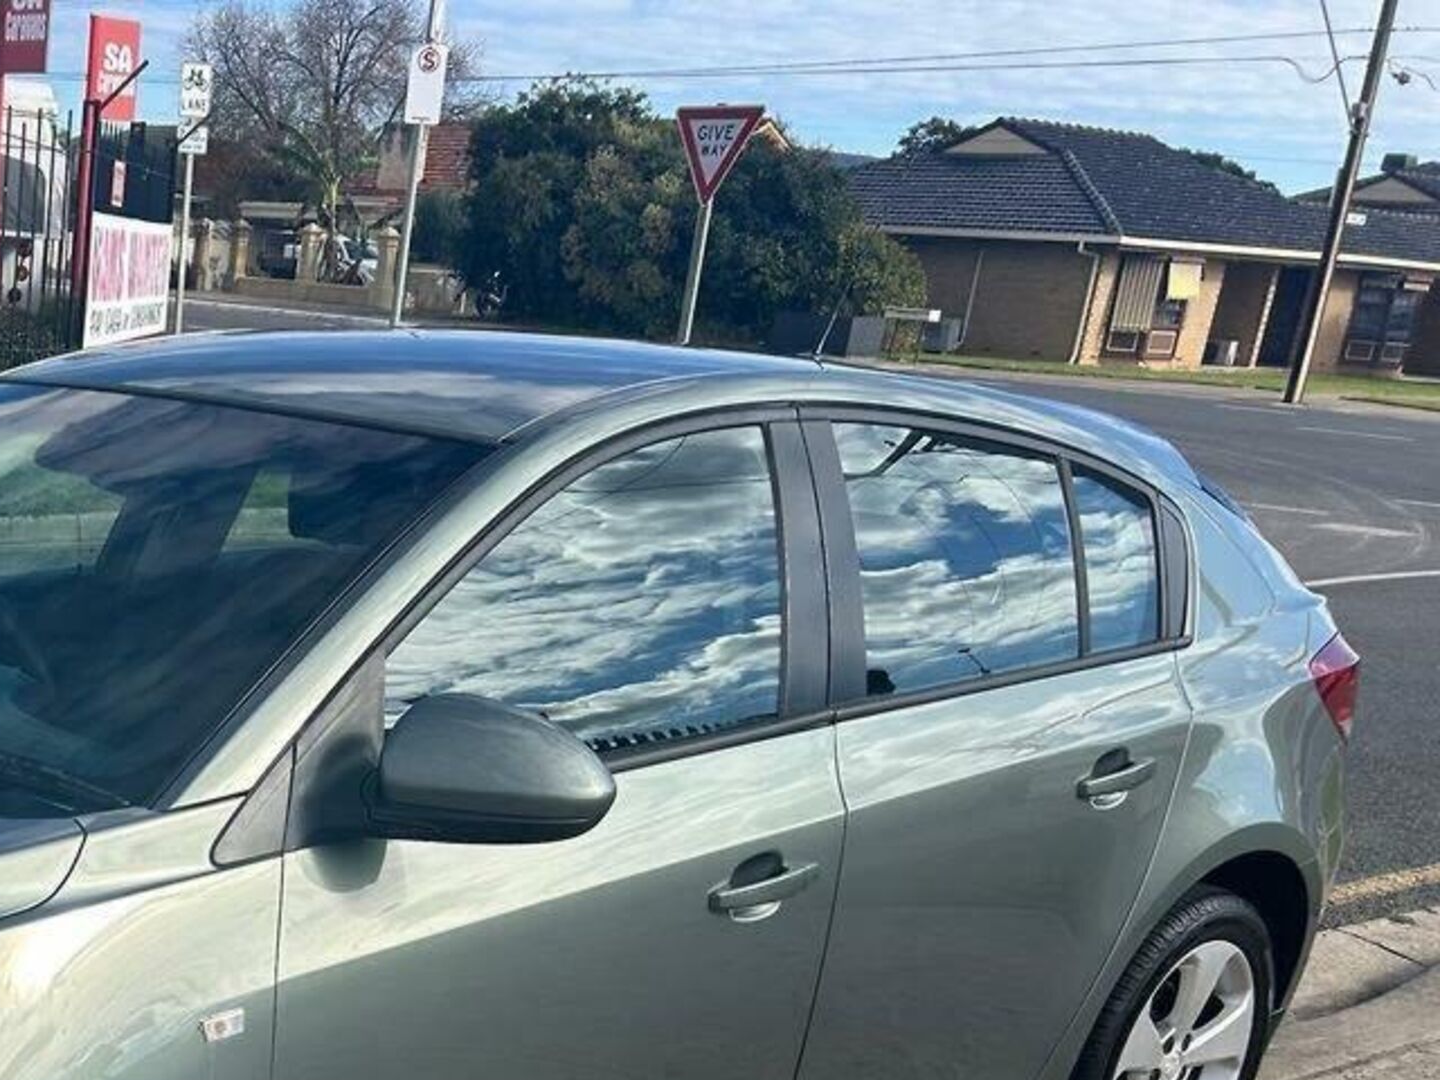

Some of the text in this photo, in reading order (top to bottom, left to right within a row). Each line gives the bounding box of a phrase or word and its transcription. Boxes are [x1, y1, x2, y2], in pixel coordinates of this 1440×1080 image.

[103, 42, 134, 72] SA
[423, 51, 435, 70] S
[697, 125, 736, 141] GIVE
[701, 144, 728, 156] WAY
